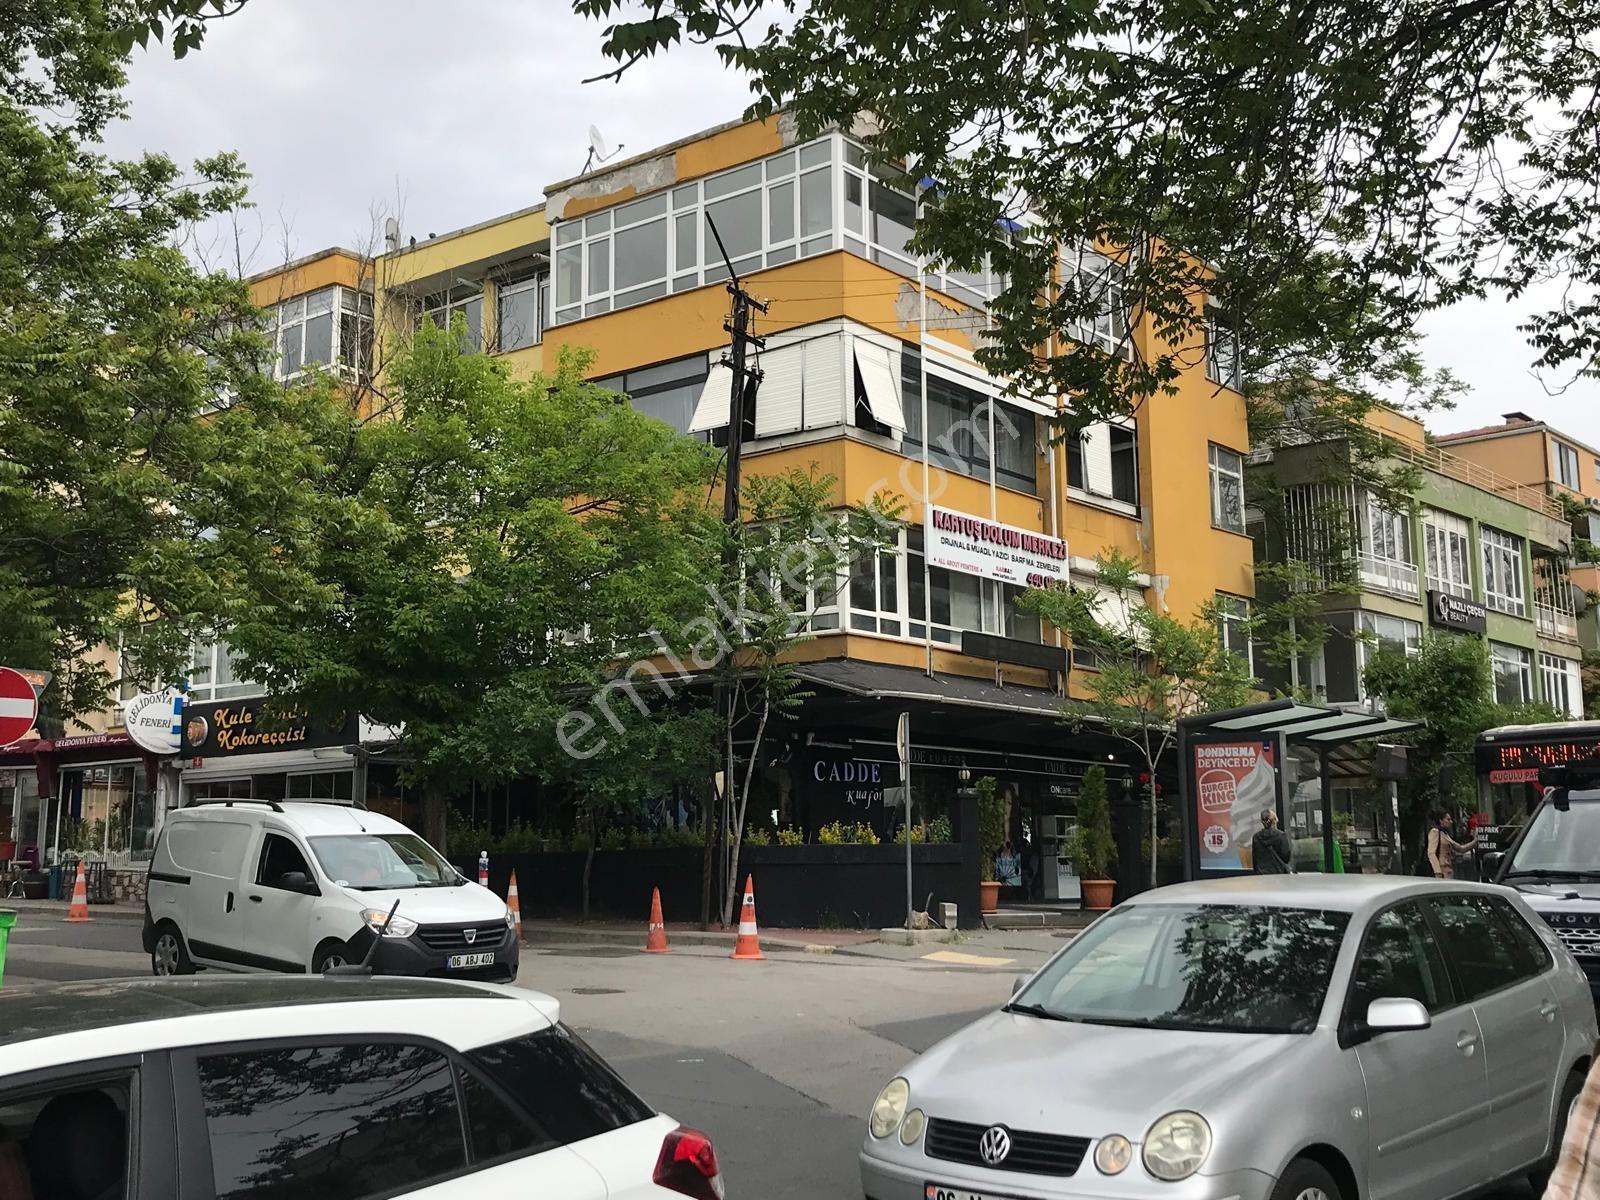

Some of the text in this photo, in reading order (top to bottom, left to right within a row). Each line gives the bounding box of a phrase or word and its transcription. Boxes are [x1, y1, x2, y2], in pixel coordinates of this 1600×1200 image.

[933, 510, 1067, 561] KARTUŞ DOLUM MERKEZİ
[128, 694, 173, 725] GELİDONYA
[140, 717, 172, 728] FENERİ
[214, 706, 253, 728] Kule
[217, 726, 306, 750] Kokoreççisi
[1197, 747, 1256, 758] DONDURMA
[1198, 757, 1256, 768] DEYİNCE DE
[814, 760, 881, 783] CADDE
[1201, 781, 1234, 794] BURGER
[1202, 791, 1236, 805] KING
[1550, 914, 1600, 924] ROV
[452, 953, 494, 967] 06 ABJ 402
